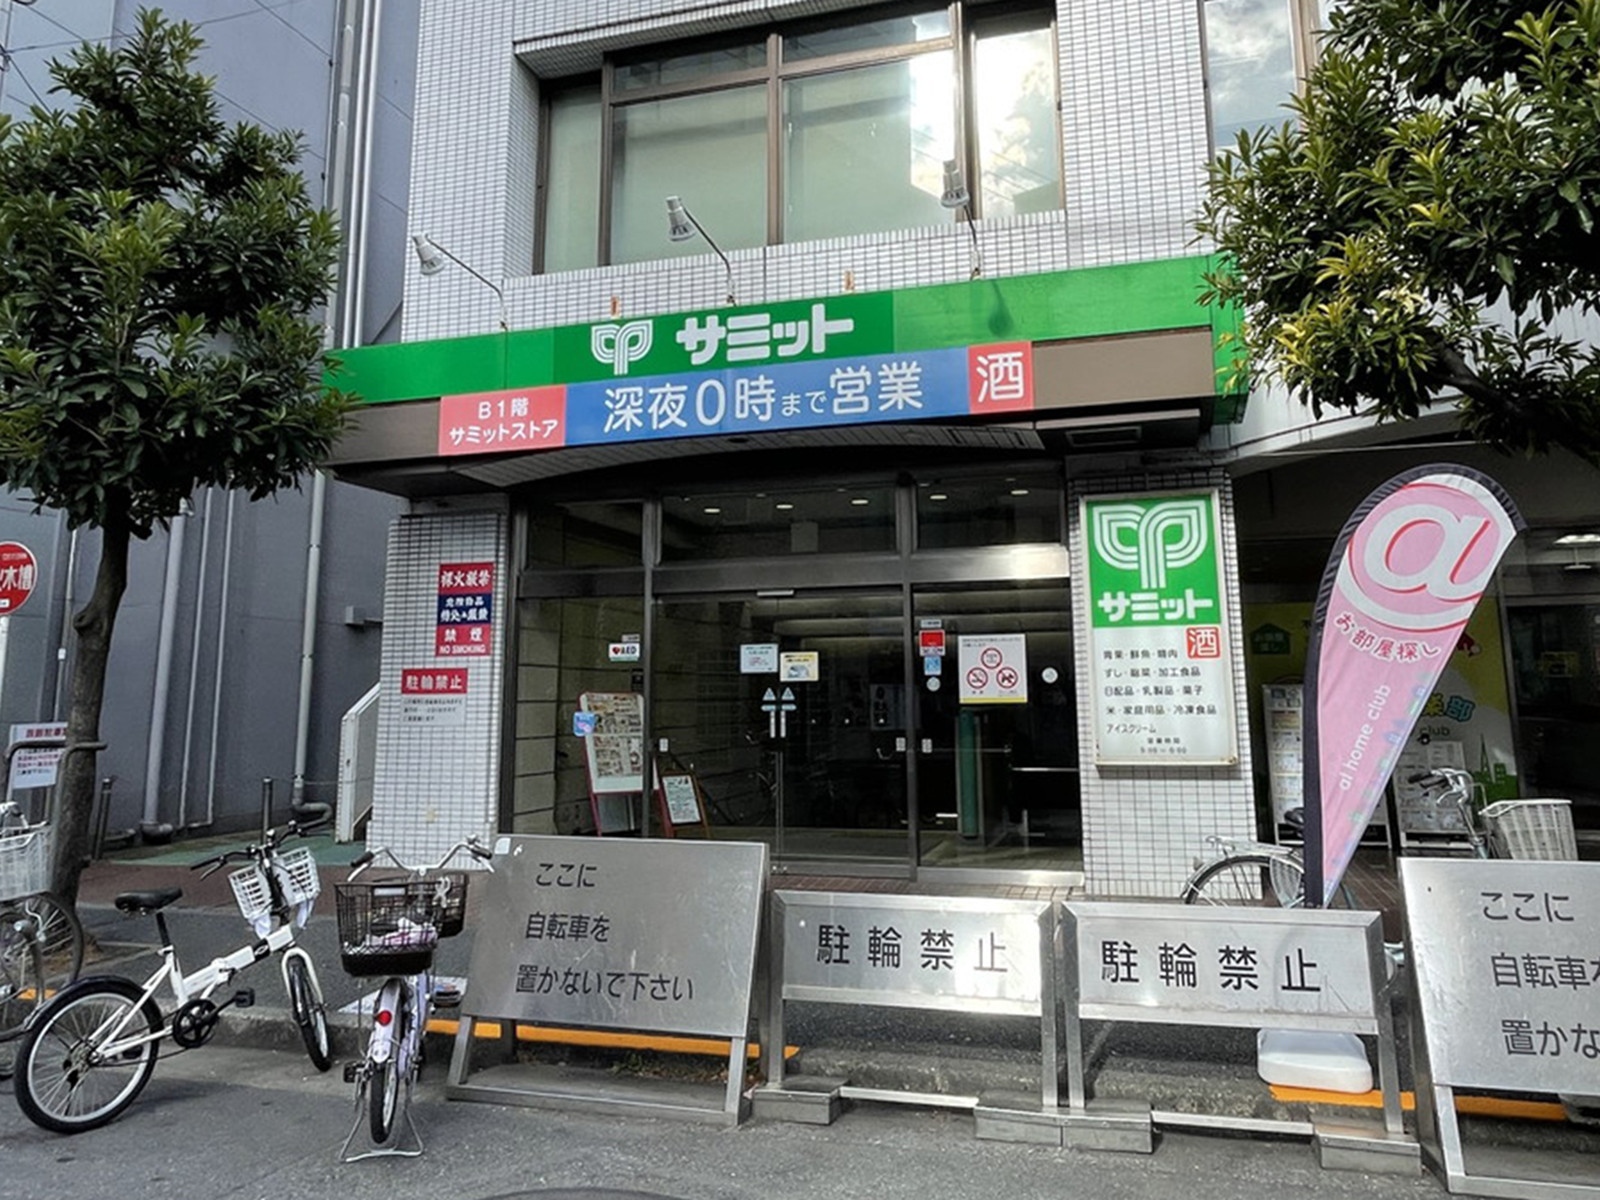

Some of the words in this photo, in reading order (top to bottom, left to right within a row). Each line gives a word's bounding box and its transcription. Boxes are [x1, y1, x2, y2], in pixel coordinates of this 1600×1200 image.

[676, 303, 854, 365] サミット
[976, 351, 1024, 402] 酒
[478, 397, 529, 419] B1階
[603, 361, 924, 433] 深夜0時まで営業
[449, 419, 558, 445] サミットストア
[1098, 588, 1213, 622] サミット
[621, 646, 637, 655] AED
[1188, 628, 1219, 658] 酒
[1336, 613, 1439, 660] お部屋探し
[405, 674, 463, 691] 駐輪禁止
[1343, 723, 1373, 772] home
[1367, 685, 1391, 721] club
[535, 863, 597, 889] ここに
[1481, 892, 1575, 923] ここに
[524, 913, 610, 943] 自転車を
[816, 924, 1008, 974] 駐輪禁止
[516, 964, 694, 1000] 置かないで下さい
[1100, 940, 1321, 993] 駐輪禁止
